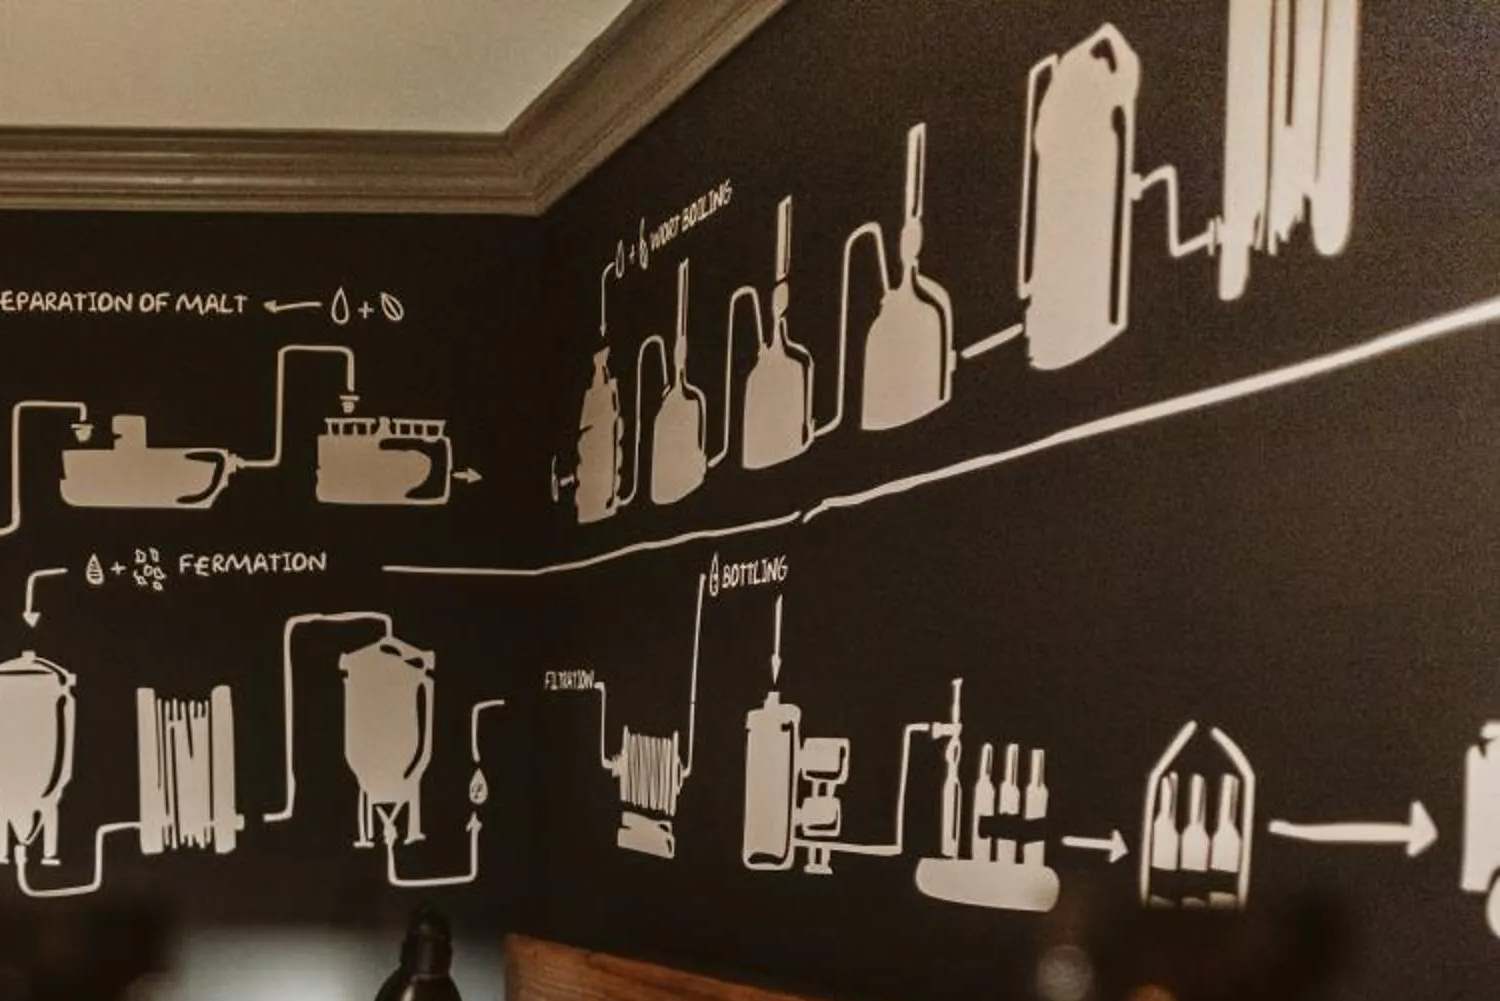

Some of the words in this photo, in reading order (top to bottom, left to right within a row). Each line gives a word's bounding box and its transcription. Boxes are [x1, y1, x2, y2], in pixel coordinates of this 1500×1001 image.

[681, 177, 733, 232] BOILING
[139, 291, 170, 312] OF
[175, 294, 248, 315] MALT
[179, 552, 327, 577] FERMATION
[721, 554, 789, 589] BOTTLING
